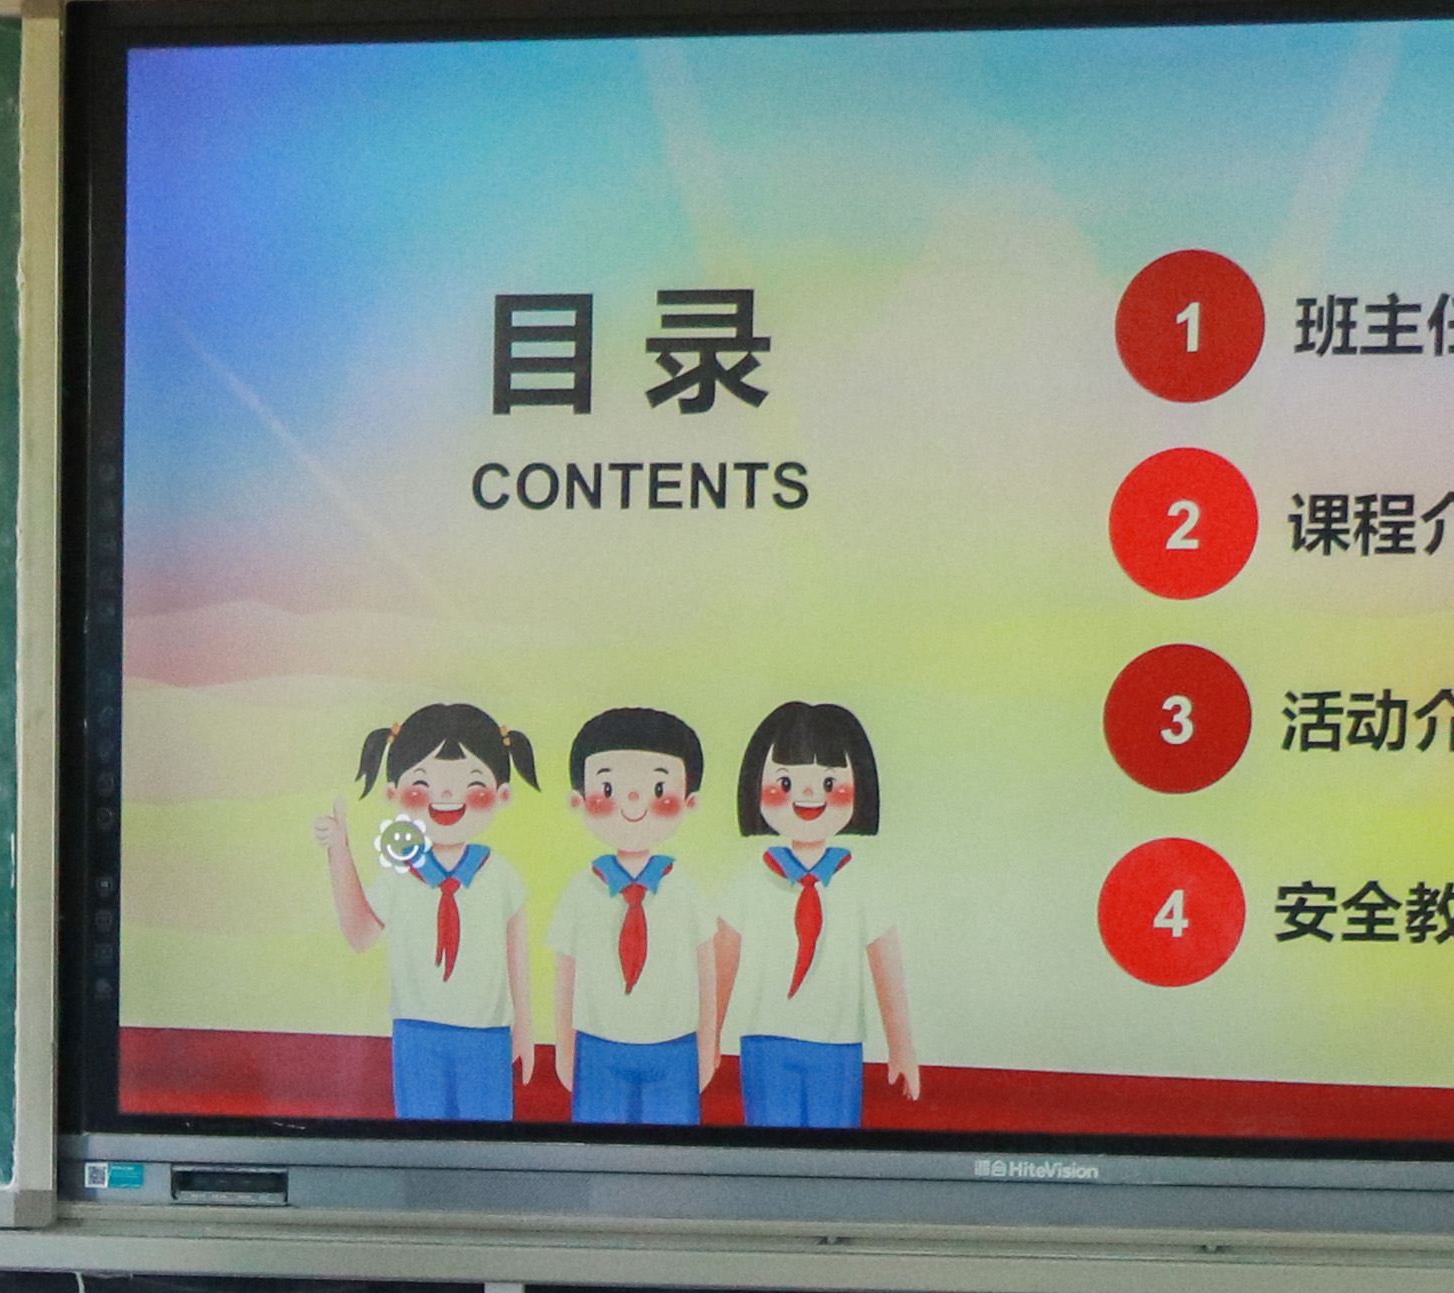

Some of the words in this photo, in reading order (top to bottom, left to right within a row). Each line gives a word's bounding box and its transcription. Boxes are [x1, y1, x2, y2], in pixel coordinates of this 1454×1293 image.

[493, 288, 771, 415] 目录
[1175, 301, 1201, 353] 1
[472, 461, 810, 511] CONTENTS
[1165, 499, 1201, 551] 2
[1159, 693, 1195, 745] 3
[1152, 888, 1189, 939] 4
[1008, 1160, 1099, 1180] HiteVision
